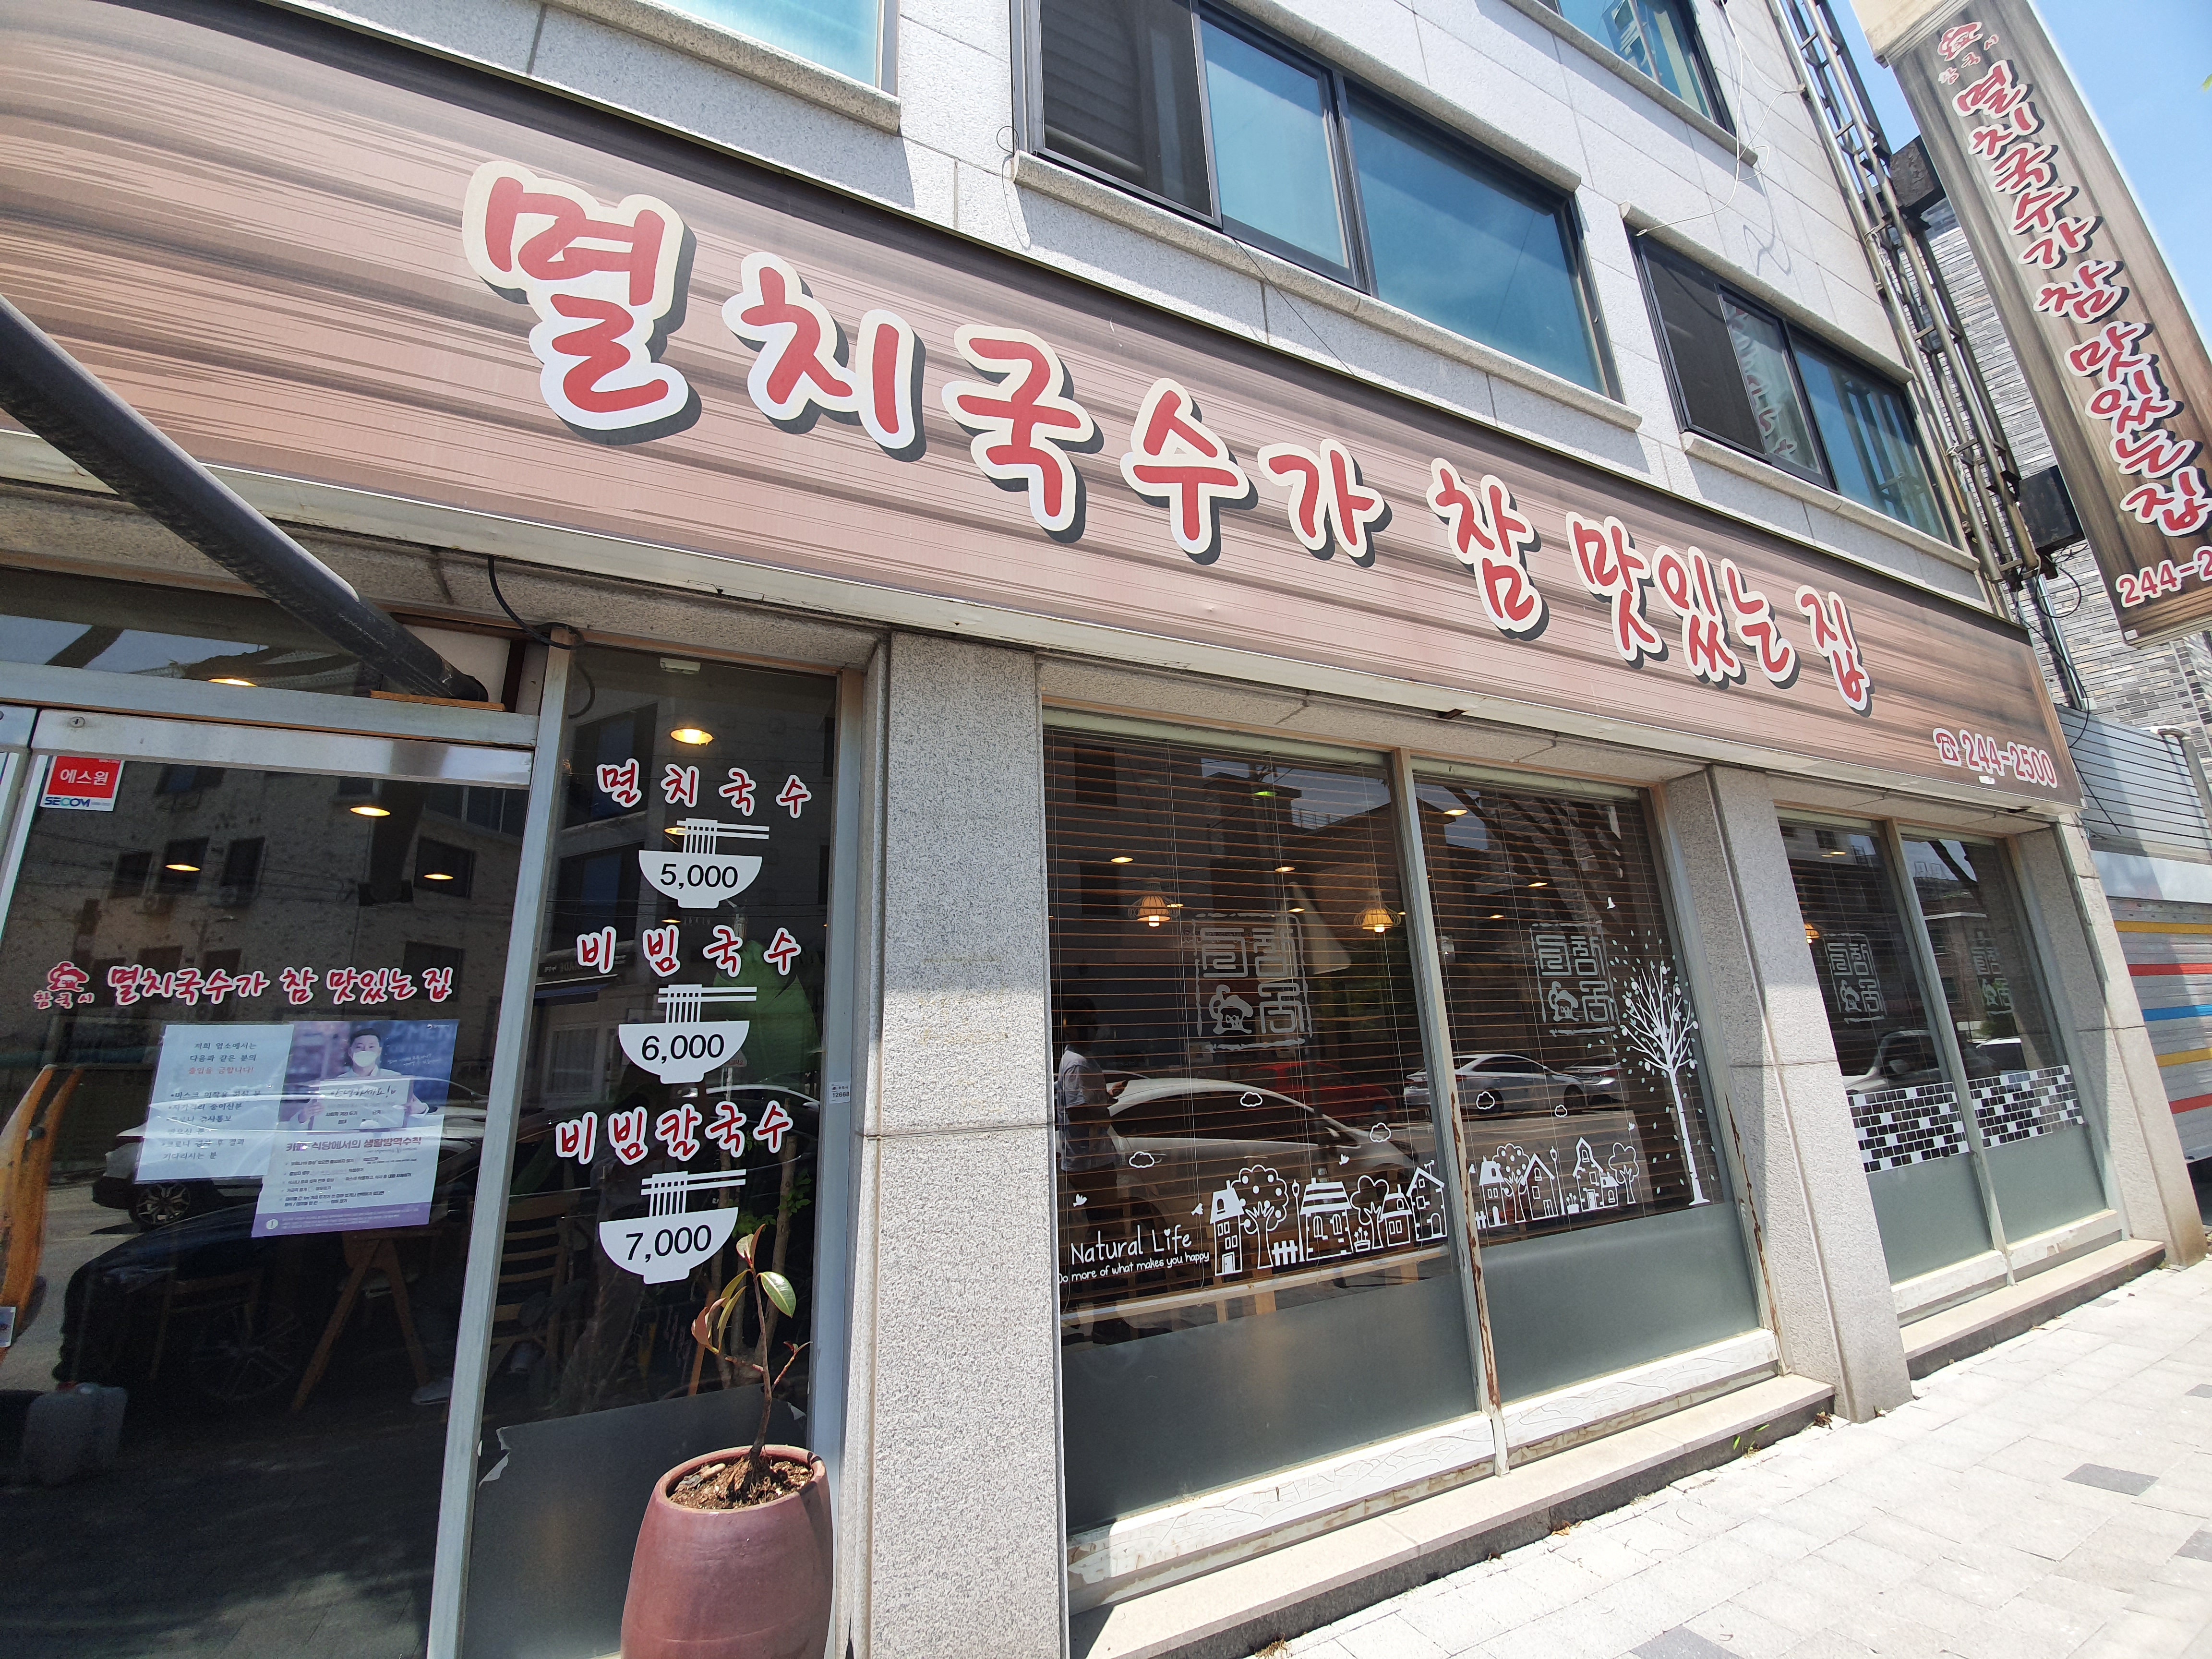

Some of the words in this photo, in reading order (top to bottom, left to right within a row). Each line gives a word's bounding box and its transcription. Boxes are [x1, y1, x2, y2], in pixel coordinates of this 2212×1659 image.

[1953, 60, 2096, 269] 멸치국수가
[2033, 260, 2117, 324] 참
[2064, 322, 2195, 478] 맛있는
[462, 161, 1385, 557] 멸치국수가
[1431, 457, 1541, 632] 참
[1566, 512, 1797, 682] 맛있는
[1796, 585, 1871, 710] 집
[2119, 466, 2212, 536] 집
[60, 769, 109, 786] 에스원
[1959, 729, 2057, 788] 244-2500
[45, 797, 90, 807] SECOM
[660, 863, 738, 890] 5,000
[34, 990, 95, 1009] 참국시
[107, 964, 271, 1006] 멸치국수가
[279, 967, 319, 1004] 참
[326, 967, 417, 1004] 맛있는
[422, 967, 453, 1002] 집
[641, 1034, 724, 1064] 6,000
[555, 1100, 793, 1165] 비빔칼국수
[625, 1224, 712, 1263] 7,000
[1071, 1225, 1143, 1265] Natural
[1152, 1225, 1191, 1254] Life
[1071, 1268, 1097, 1282] more
[1100, 1265, 1110, 1276] of
[1112, 1263, 1134, 1275] what
[1136, 1258, 1164, 1270] makes
[1166, 1256, 1183, 1268] you
[1185, 1251, 1210, 1264] happy
